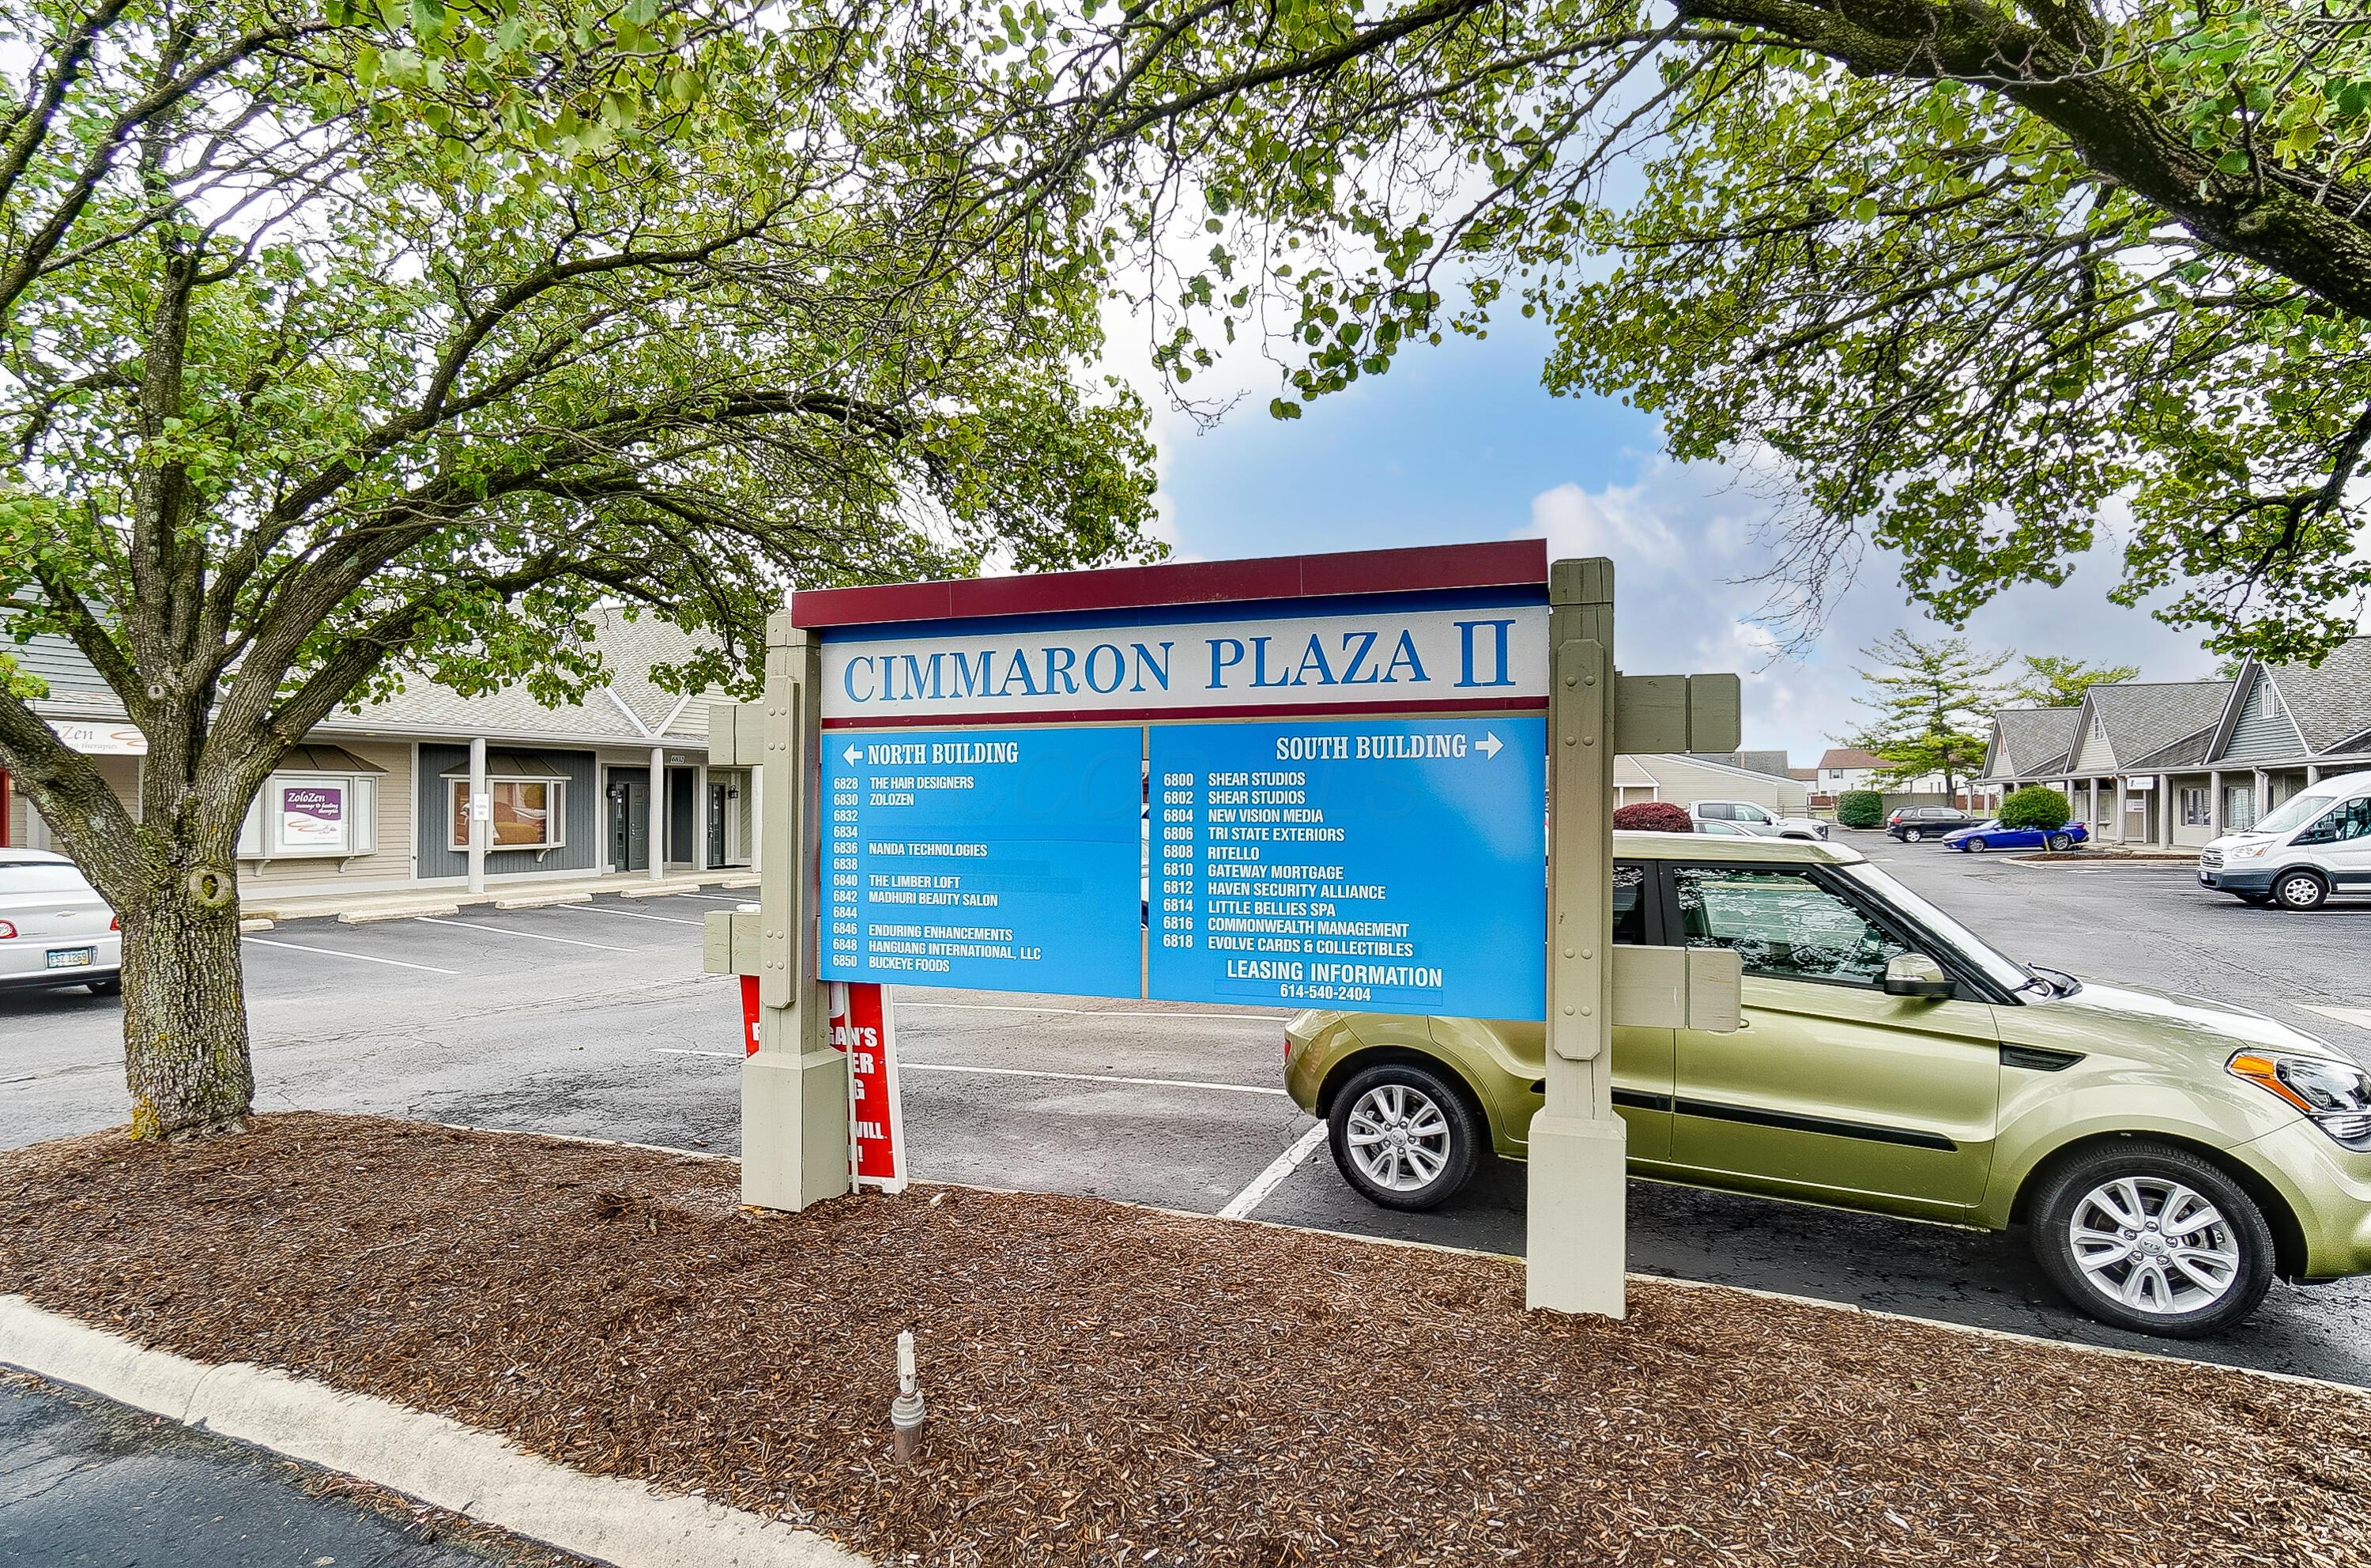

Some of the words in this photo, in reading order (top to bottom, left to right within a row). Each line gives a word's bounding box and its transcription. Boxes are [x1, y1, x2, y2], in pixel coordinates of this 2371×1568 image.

[843, 641, 1175, 703] CIMMARON
[1204, 628, 1431, 690] PLAZA
[1452, 619, 1517, 688] II
[59, 726, 93, 740] Zen
[867, 744, 927, 765] NORTH
[932, 741, 1019, 764] BUILDING
[1276, 736, 1348, 760] SOUTH
[1355, 733, 1468, 759] BUILDING
[834, 777, 858, 790] 6828
[869, 777, 889, 790] THE
[891, 776, 915, 790] HAIR
[916, 776, 974, 790] DESIGNERS
[1163, 773, 1193, 786] 6800
[1208, 772, 1249, 786] SHEAR
[1251, 771, 1306, 786] STUDIOS
[287, 791, 326, 803] ZoloZen
[834, 793, 858, 806] 6830
[869, 793, 914, 806] ZOLOZEN
[1163, 791, 1193, 805] 6802
[1208, 790, 1249, 805] SHEAR
[1251, 790, 1306, 805] STUDIOS
[834, 809, 858, 822] 6832
[1163, 808, 1193, 823] 6804
[1208, 808, 1237, 823] NEW
[1238, 808, 1280, 823] VISION
[1283, 808, 1324, 823] MEDIA
[833, 825, 858, 839] 6834
[1163, 827, 1193, 840] 6806
[1208, 827, 1228, 840] TRI
[1231, 827, 1270, 841] STATE
[1272, 827, 1344, 842] EXTERIORS
[833, 842, 858, 854] 6836
[869, 842, 906, 855] NANDA
[907, 843, 988, 857] TECHNOLOGIES
[1163, 844, 1193, 858] 6808
[1208, 846, 1260, 861] RITELLO
[833, 858, 858, 870] 6838
[1163, 862, 1193, 876] 6810
[1208, 864, 1268, 878] GATEWAY
[1271, 865, 1344, 880] MORTGAGE
[833, 873, 858, 887] 6840
[869, 874, 890, 887] THE
[891, 875, 932, 888] LIMBER
[933, 876, 961, 889] LOFT
[1163, 880, 1193, 895] 6812
[1208, 882, 1250, 896] HAVEN
[1253, 882, 1317, 898] SECURITY
[1320, 884, 1386, 899] ALLIANCE
[833, 890, 858, 903] 6842
[869, 891, 917, 904] MADHURI
[918, 892, 961, 906] BEAUTY
[962, 893, 998, 906] SALON
[833, 906, 858, 919] 6844
[1163, 898, 1193, 912] 6814
[1208, 900, 1251, 914] LITTLE
[1254, 901, 1307, 916] BELLIES
[1310, 903, 1336, 917] SPA
[833, 922, 858, 935] 6846
[869, 924, 922, 938] ENDURING
[924, 925, 1013, 941] ENHANCEMENTS
[1163, 915, 1193, 930] 6816
[1208, 917, 1314, 934] COMMONWEALTH
[1317, 921, 1410, 938] MANAGEMENT
[832, 937, 858, 952] 6848
[869, 940, 926, 955] HANGUANG
[928, 942, 1017, 960] INTERNATIONAL,
[1020, 947, 1041, 960] LLC
[1163, 933, 1193, 948] 6818
[1208, 936, 1255, 951] EVOLVE
[1257, 937, 1301, 953] CARDS
[1303, 939, 1314, 953] &
[1316, 940, 1413, 957] COLLECTIBLES
[832, 954, 858, 967] 6850
[869, 956, 914, 971] BUCKEYE
[915, 958, 950, 972] FOODS
[1227, 959, 1303, 981] LEASING
[1310, 963, 1442, 987] INFORMATION
[1280, 983, 1371, 1001] 614-540-2404
